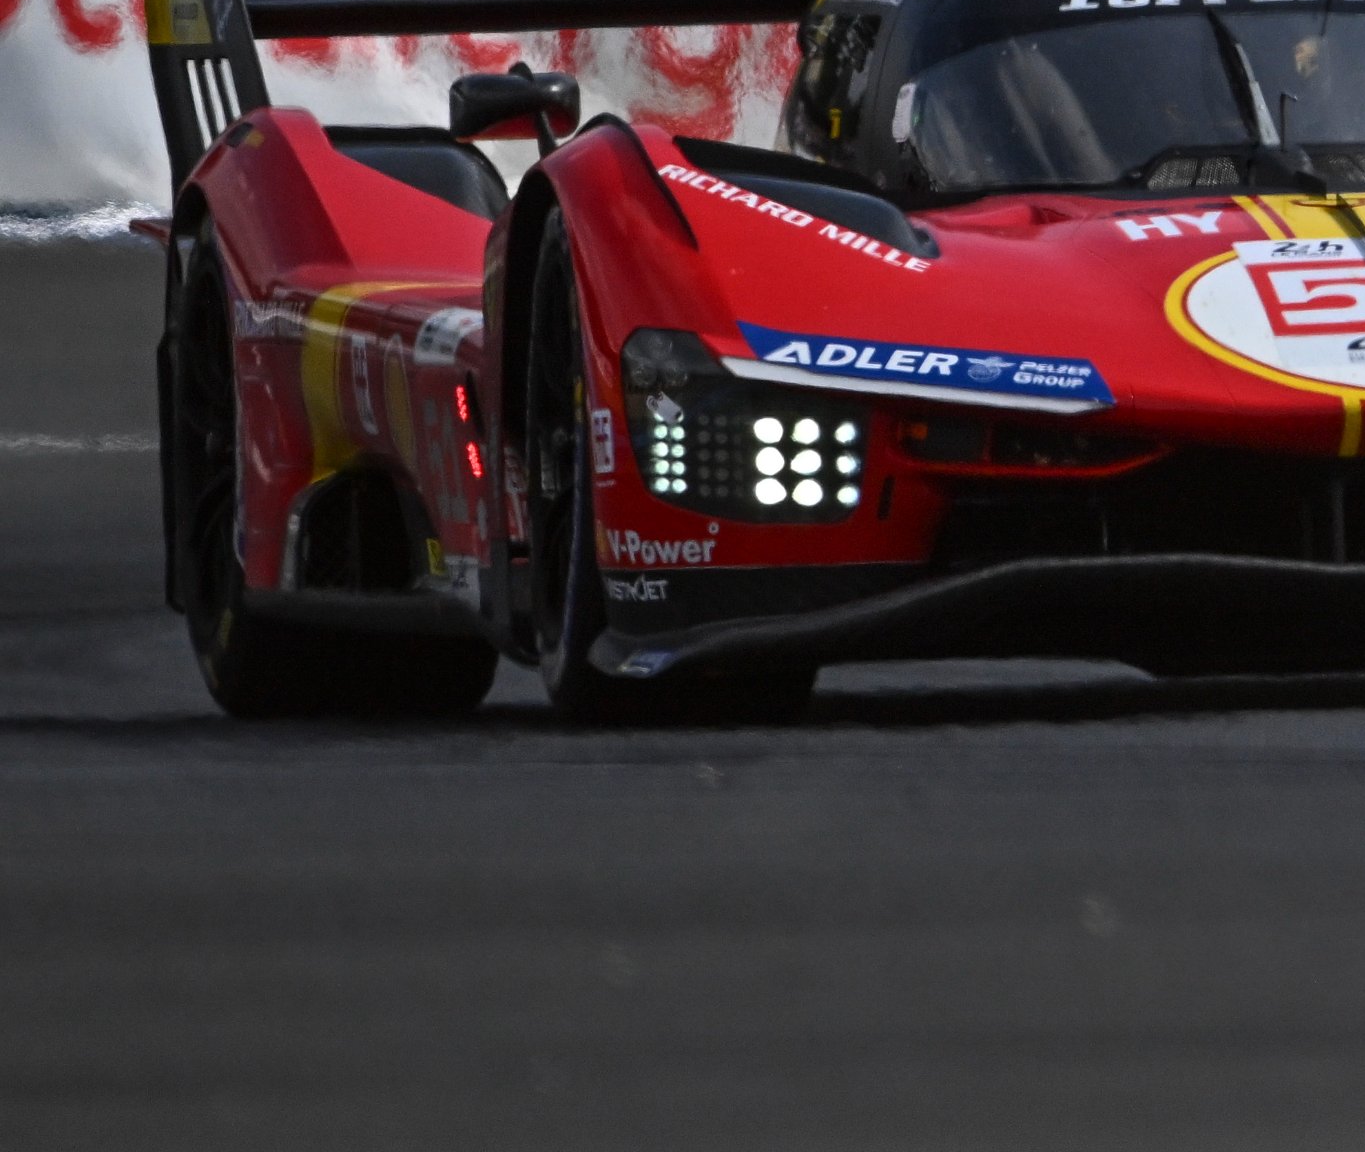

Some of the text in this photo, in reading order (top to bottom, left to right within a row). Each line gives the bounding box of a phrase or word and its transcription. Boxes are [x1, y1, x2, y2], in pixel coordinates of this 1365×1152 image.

[658, 163, 933, 273] RICHARD MILLE
[1114, 211, 1224, 242] HY
[762, 341, 959, 377] ADLER
[1019, 360, 1092, 379] PELZER
[1013, 371, 1086, 390] GROUP
[607, 529, 717, 565] V-Power
